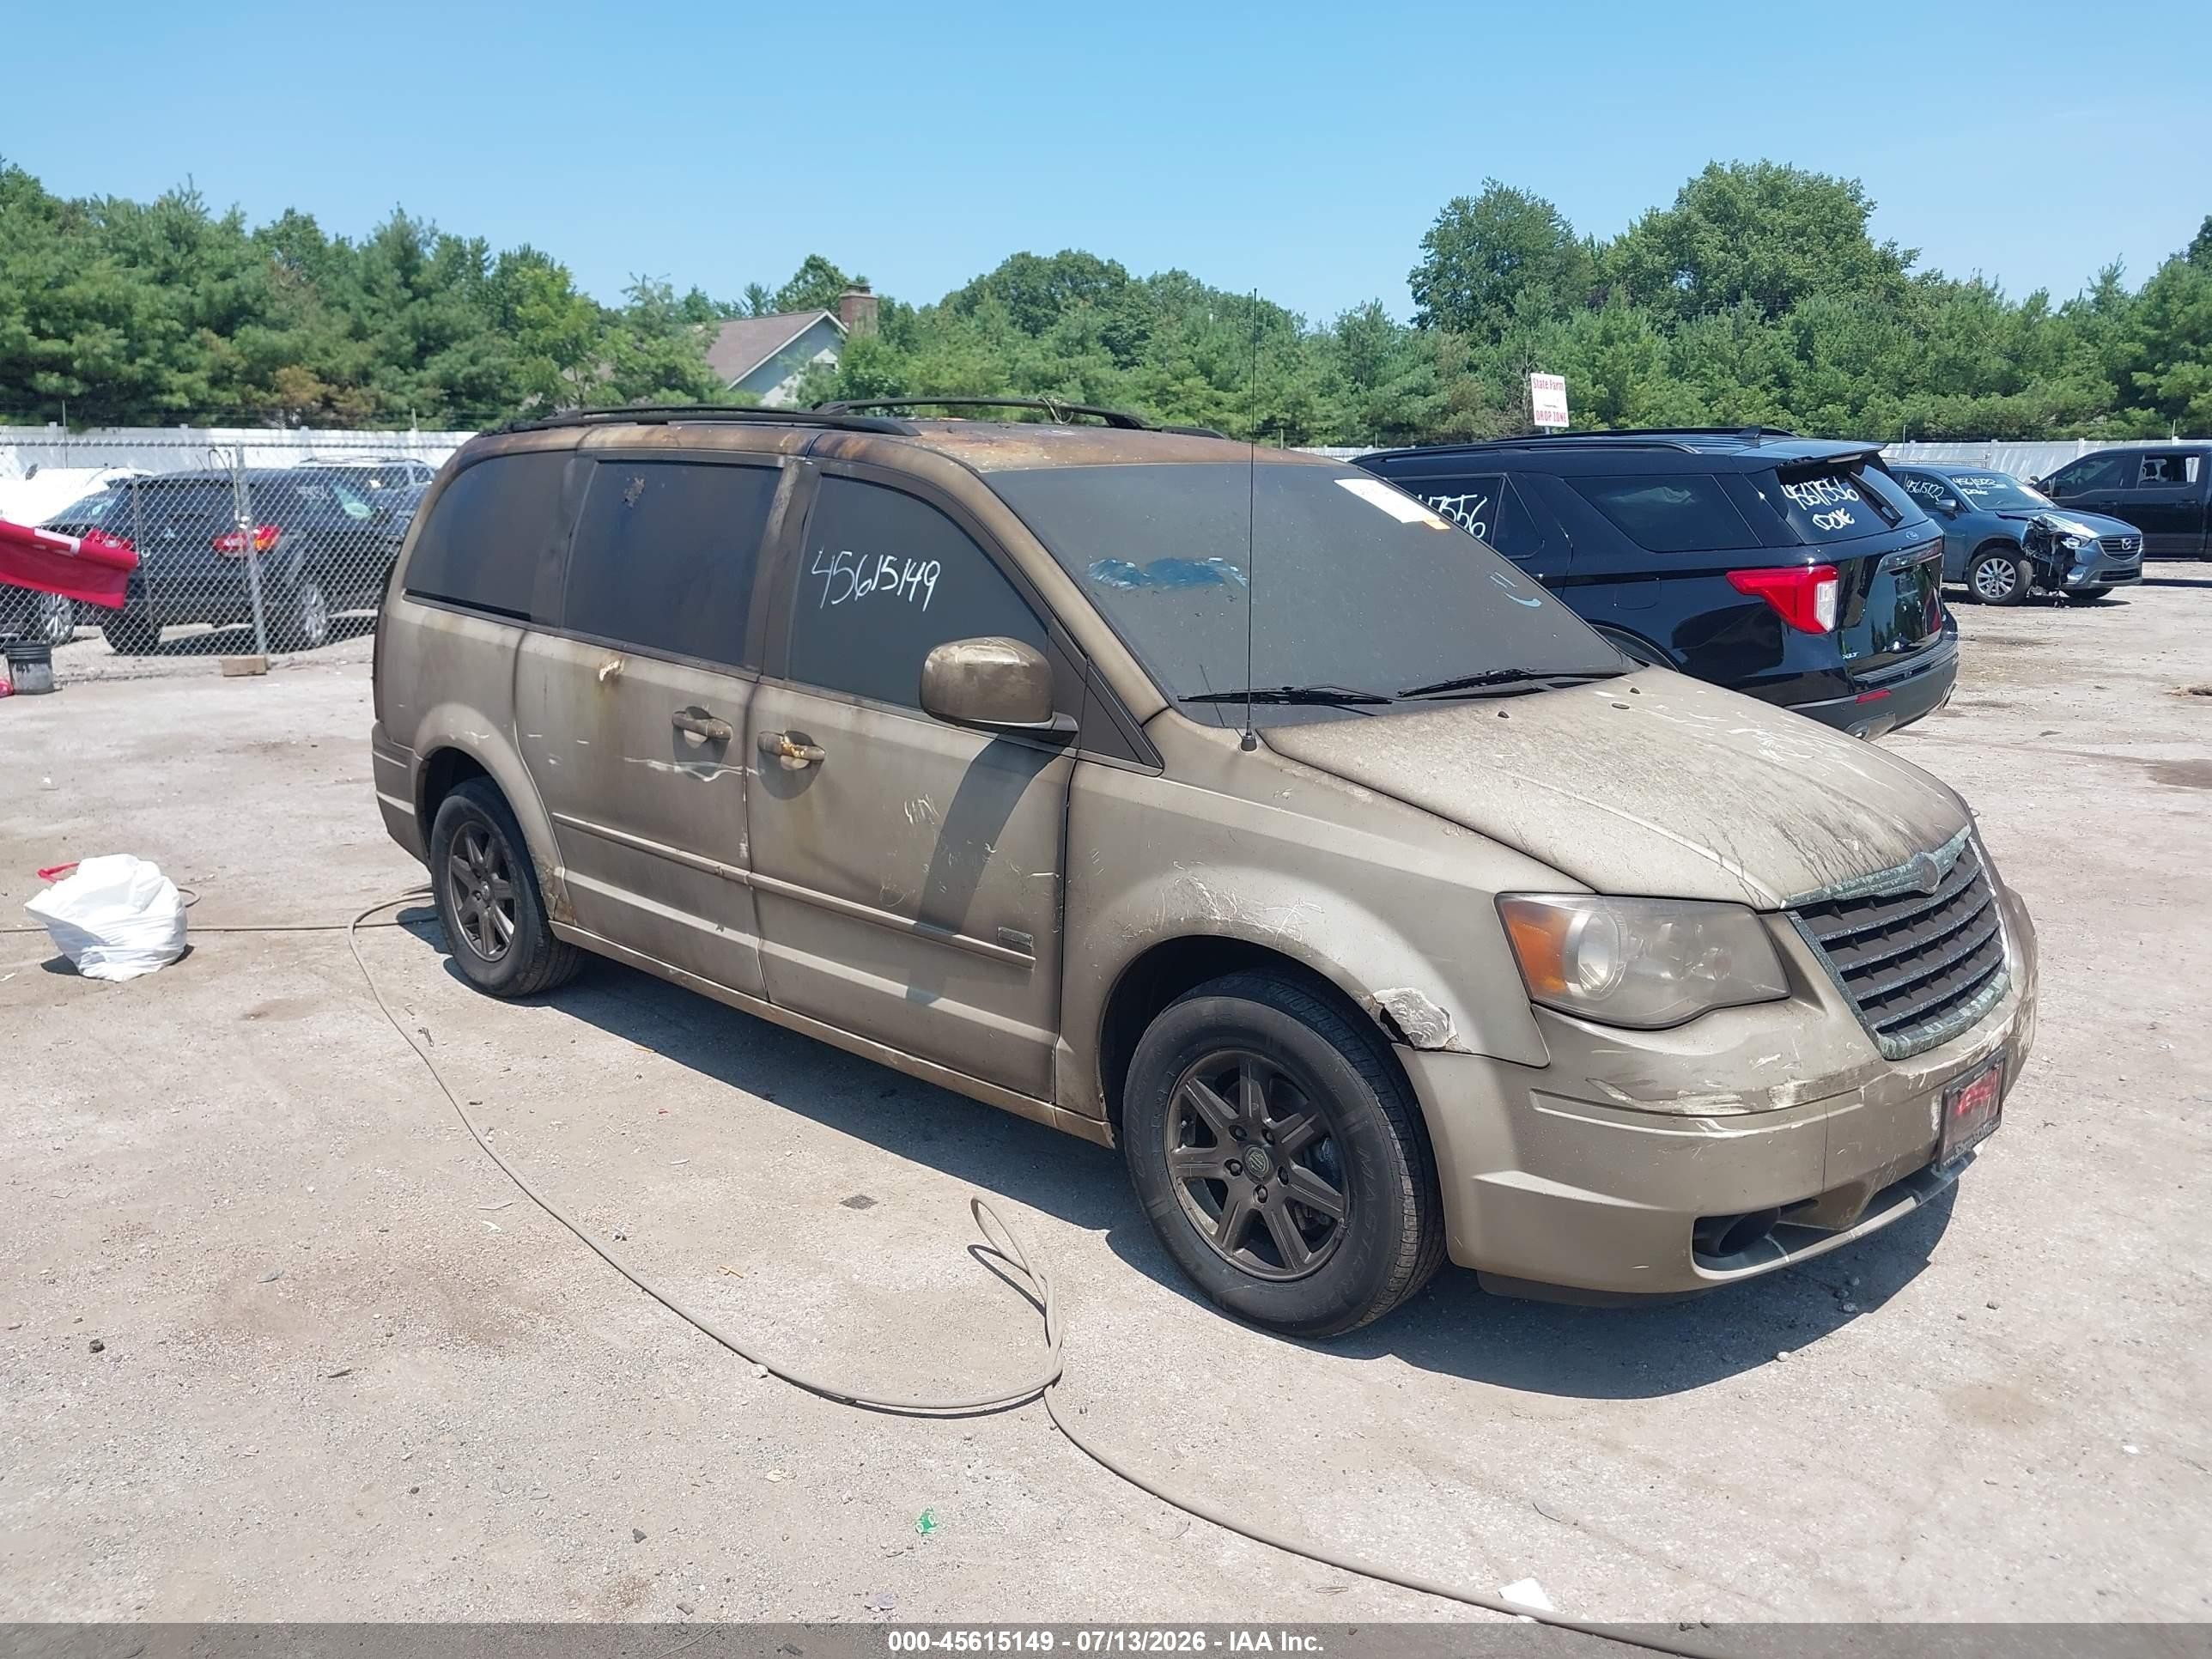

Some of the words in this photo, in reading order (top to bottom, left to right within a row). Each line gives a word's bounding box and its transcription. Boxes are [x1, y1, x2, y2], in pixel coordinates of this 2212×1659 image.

[1533, 378, 1548, 390] State
[1550, 379, 1565, 392] Farm
[811, 544, 941, 612] 45615149
